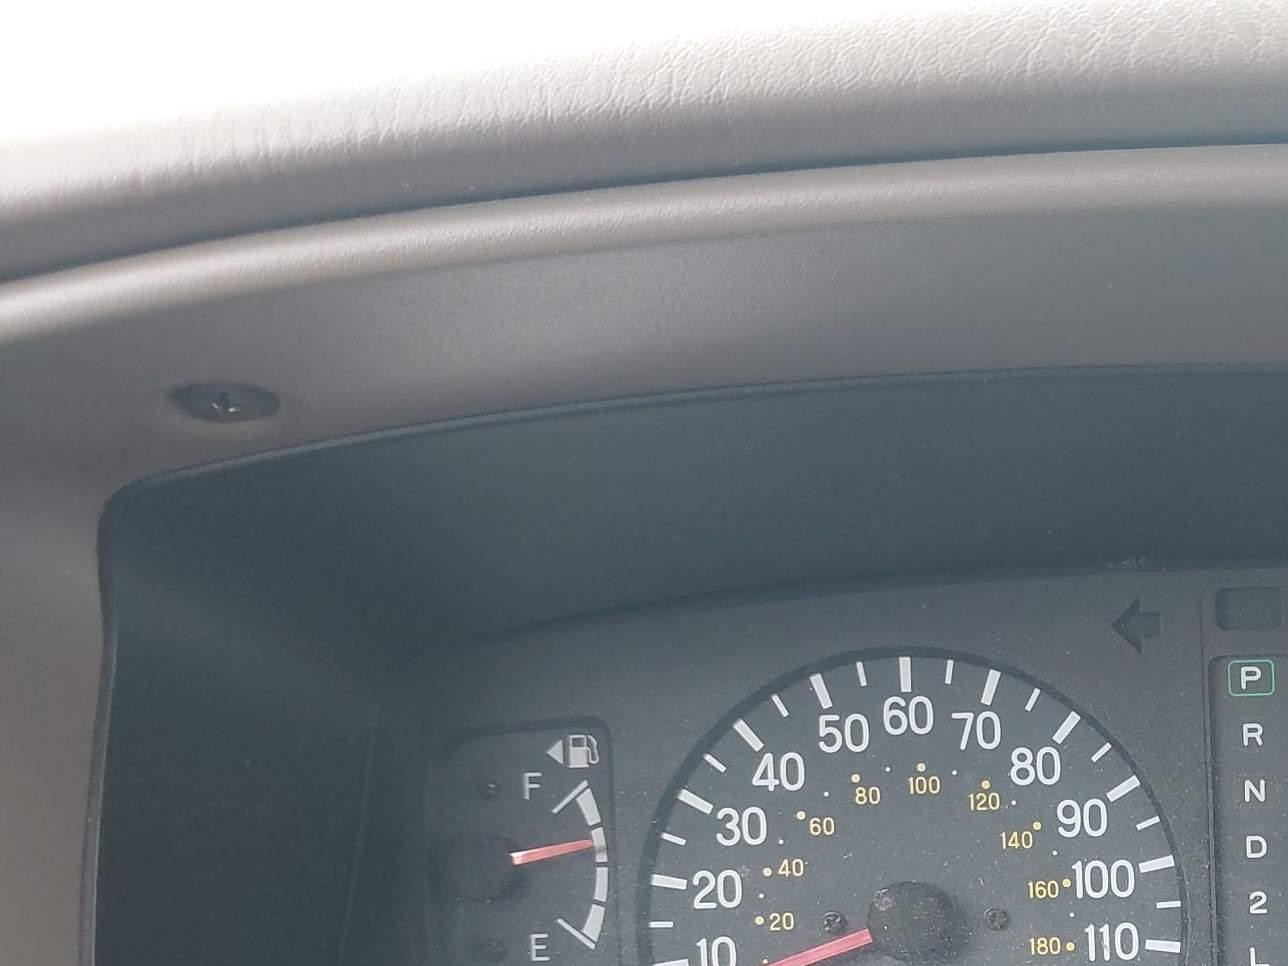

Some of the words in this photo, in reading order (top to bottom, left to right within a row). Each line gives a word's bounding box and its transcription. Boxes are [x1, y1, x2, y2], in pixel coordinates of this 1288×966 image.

[1240, 666, 1262, 689] P
[883, 696, 934, 734] 60
[818, 714, 869, 752] 50
[951, 712, 1001, 750] 70
[1243, 723, 1264, 745] R
[752, 752, 805, 791] 40
[1010, 747, 1061, 785] 80
[522, 772, 542, 800] F
[854, 787, 881, 804] 80
[907, 776, 941, 794] 100
[1244, 780, 1266, 802] N
[968, 793, 1000, 810] 120
[716, 806, 767, 846] 30
[808, 818, 835, 835] 60
[1056, 799, 1108, 837] 90
[1000, 831, 1033, 849] 140
[1246, 836, 1267, 858] D
[778, 859, 805, 876] 40
[693, 870, 742, 909] 20
[1027, 881, 1059, 898] 160
[1071, 860, 1134, 898] 100
[1249, 892, 1267, 914] 2
[769, 913, 794, 930] 20
[530, 934, 550, 961] E
[1029, 938, 1061, 954] 180
[1084, 924, 1138, 961] 110
